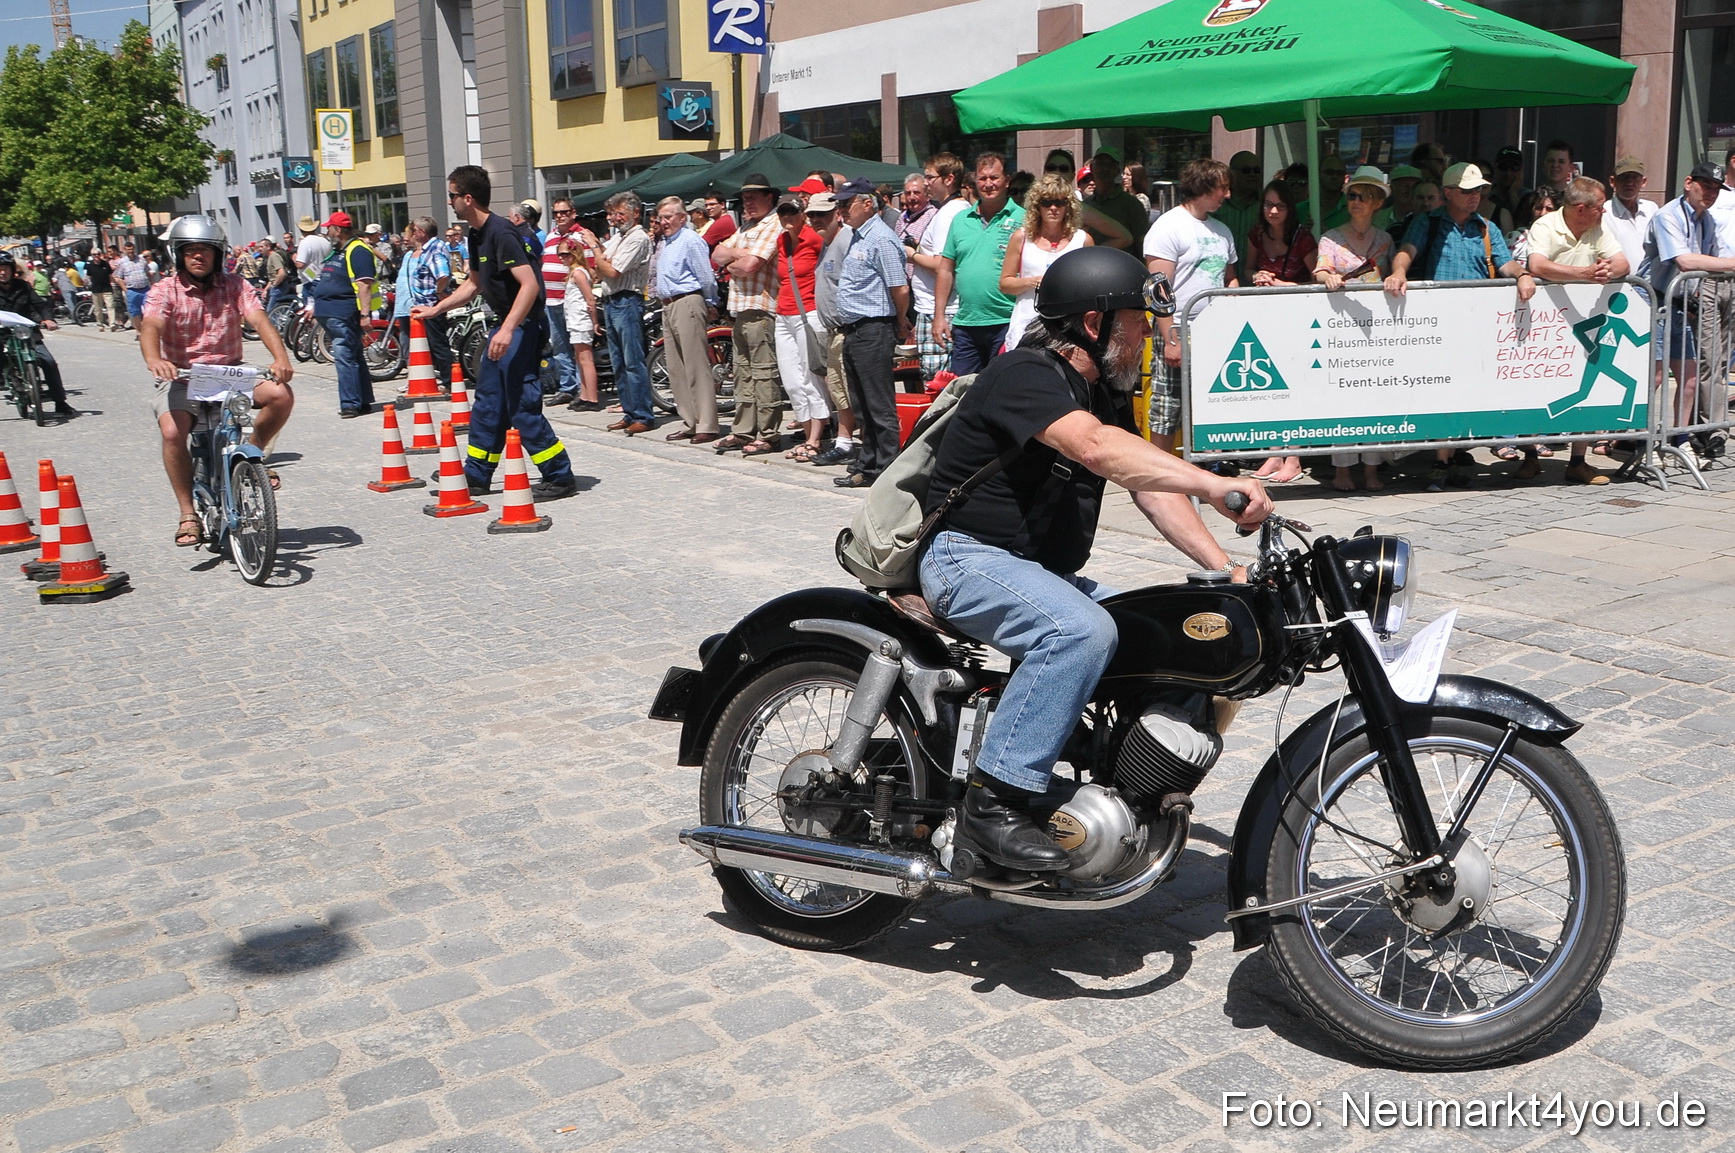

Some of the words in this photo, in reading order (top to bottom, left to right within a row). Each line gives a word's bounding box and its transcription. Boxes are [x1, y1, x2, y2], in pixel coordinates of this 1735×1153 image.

[1139, 24, 1288, 50] Neumarkter
[1095, 35, 1300, 69] Lammsbräu
[772, 72, 790, 83] Unterer
[790, 68, 805, 80] Markt
[805, 65, 812, 78] 15
[680, 97, 699, 121] G2
[1327, 315, 1438, 328] Gebäudereinigung
[1529, 307, 1569, 323] UNS
[1327, 335, 1443, 349] Hausmeisterdienste
[1327, 356, 1395, 369] Mietservice
[222, 367, 243, 377] 706
[1338, 375, 1452, 389] Event-Leit-Systeme
[1207, 421, 1416, 444] www.jura-gebaeudeservice.de
